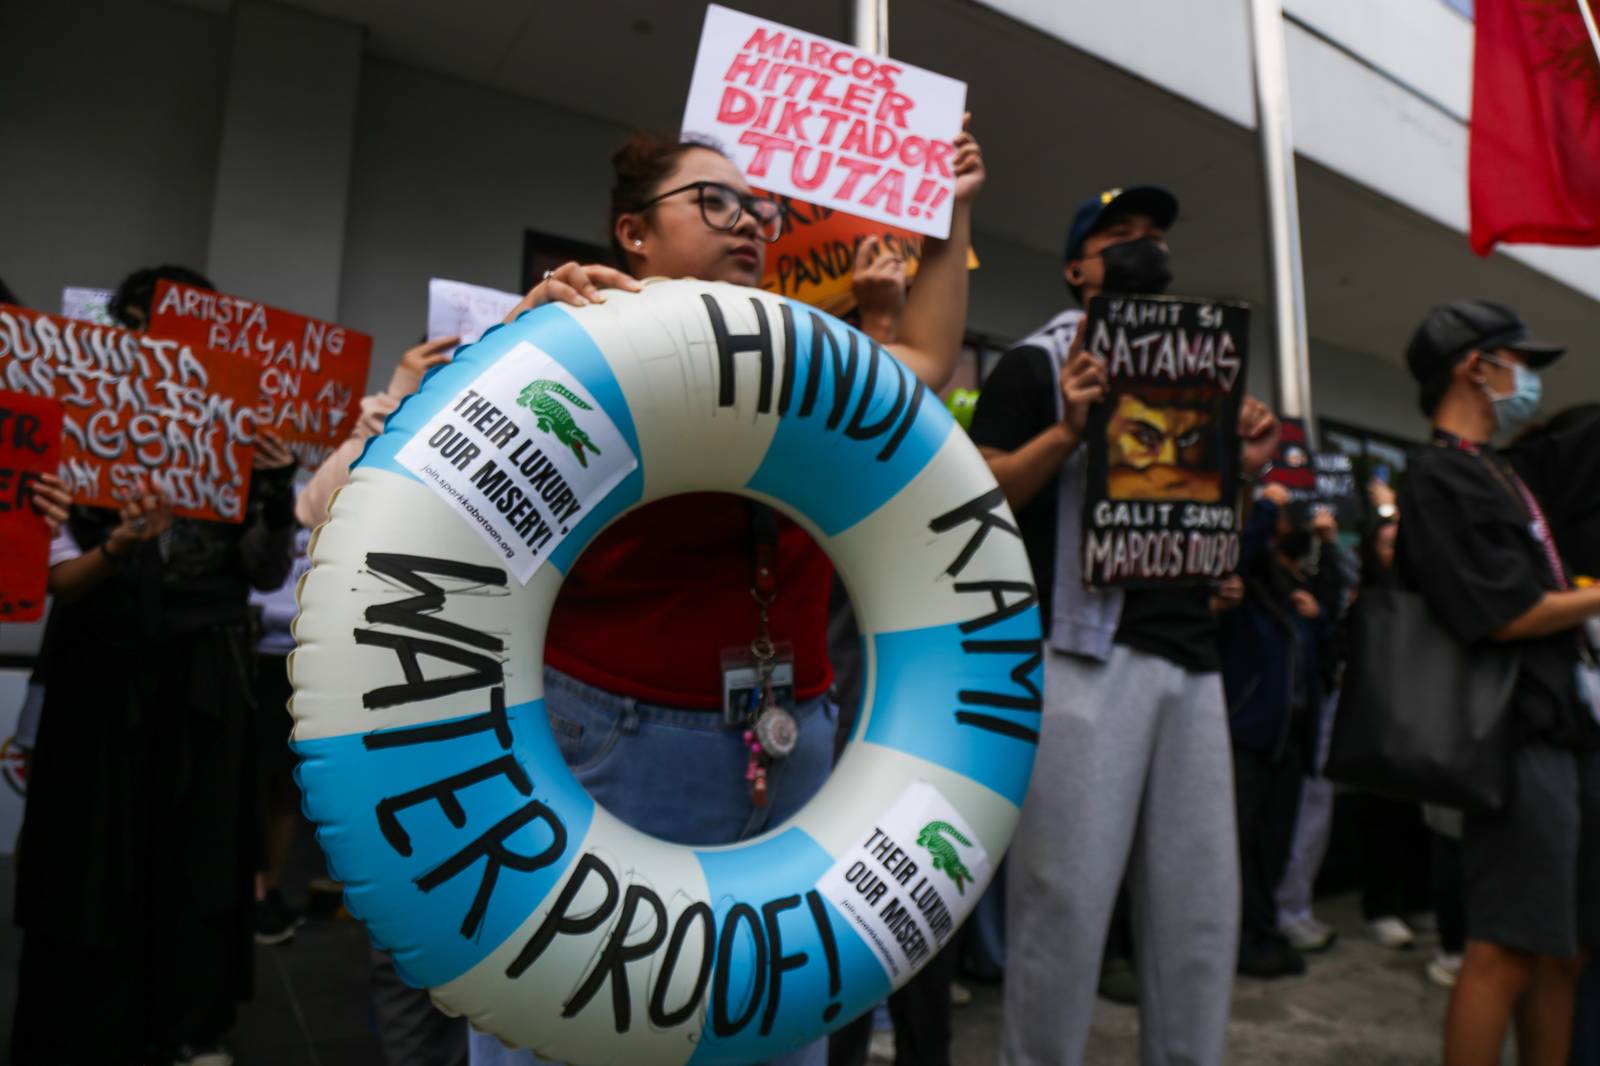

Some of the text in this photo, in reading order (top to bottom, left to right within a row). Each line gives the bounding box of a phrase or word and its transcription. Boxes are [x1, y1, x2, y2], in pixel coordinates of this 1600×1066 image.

[724, 53, 915, 128] HITLER
[743, 27, 904, 89] MARCOS
[717, 86, 955, 178] DIKTADOR
[739, 130, 949, 220] TUTA!!
[159, 284, 268, 331] ARTISTA
[303, 321, 345, 356] NG
[1108, 300, 1224, 328] KAHIT SI
[0, 357, 257, 444] APITALISMO
[428, 424, 554, 556] OUR MISERY!
[453, 390, 519, 449] THEIR
[509, 439, 581, 535] LUXURY,
[420, 463, 515, 558] join.sparkkabataan.org
[701, 293, 1043, 744] HINDI KAMI
[1094, 501, 1174, 527] GALIT
[1085, 530, 1184, 582] MARCOS
[353, 552, 842, 1038] WATER PROOF!
[845, 861, 888, 906] OUR
[863, 827, 919, 886] THEIR
